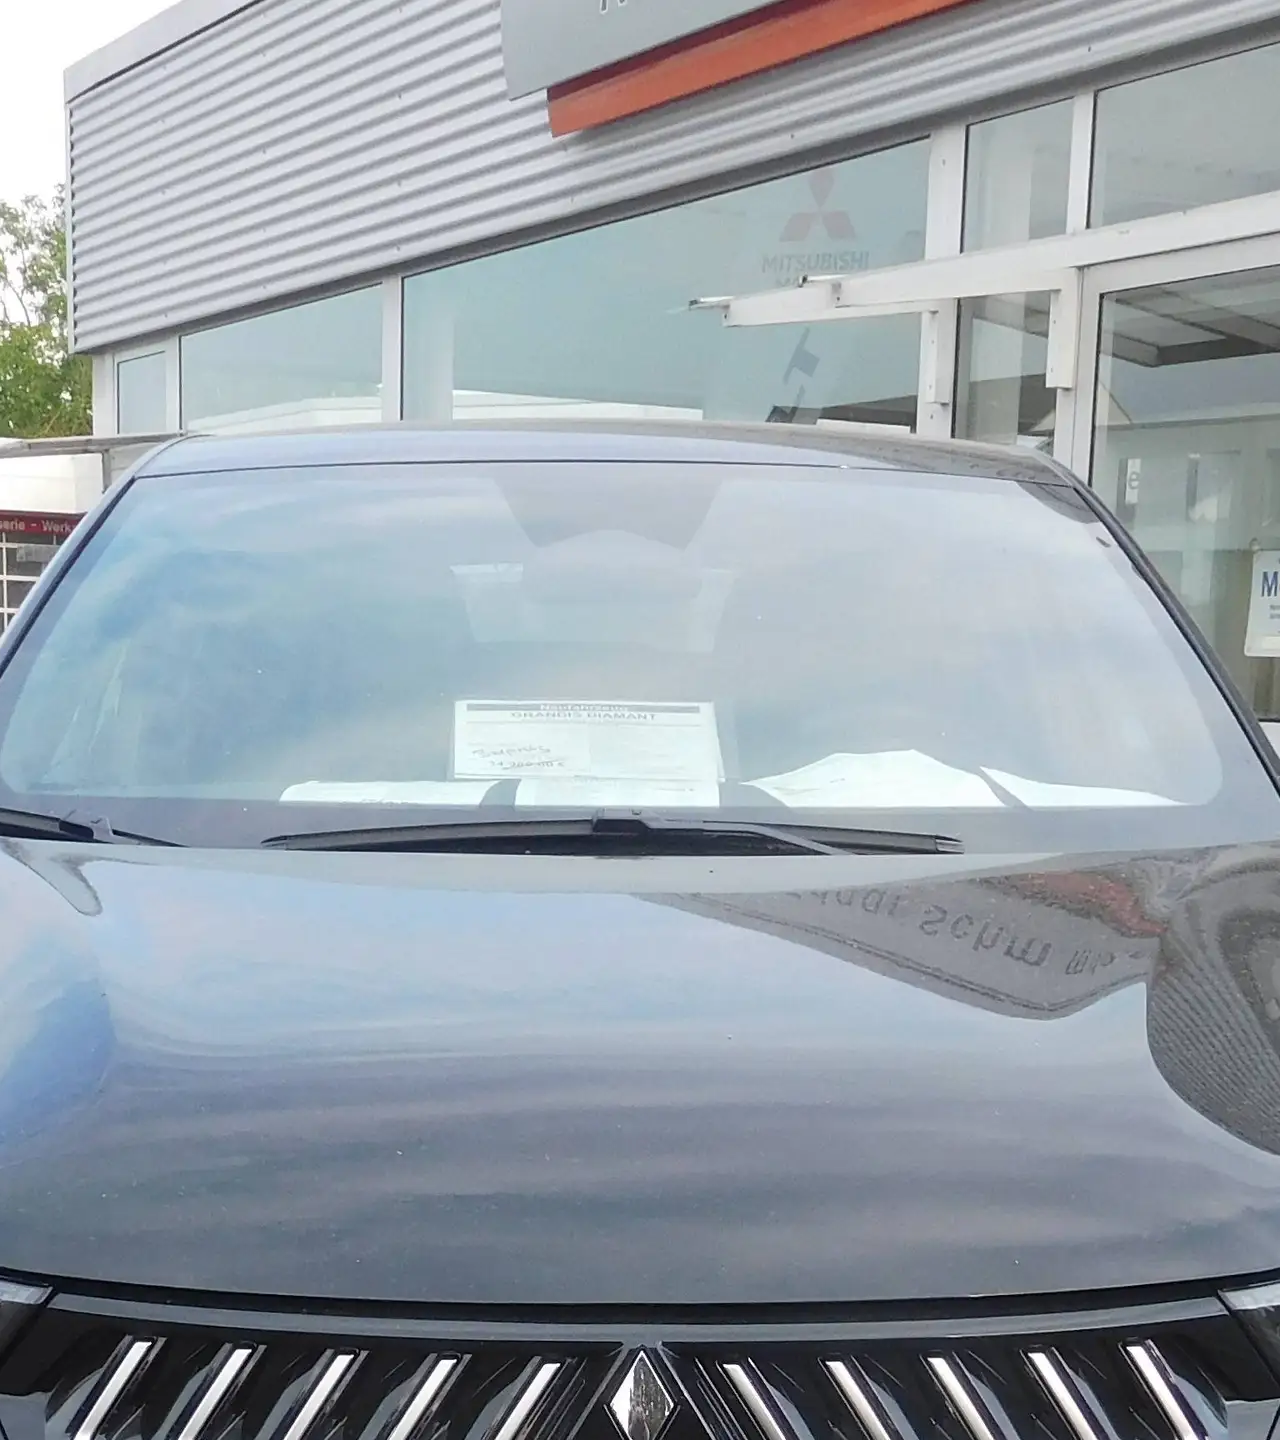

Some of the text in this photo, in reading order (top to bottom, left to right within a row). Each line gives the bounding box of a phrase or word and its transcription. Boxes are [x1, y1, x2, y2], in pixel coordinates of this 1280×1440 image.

[761, 250, 870, 273] MITSUBISHI
[41, 519, 76, 533] Werk
[587, 711, 657, 721] DIAMANT
